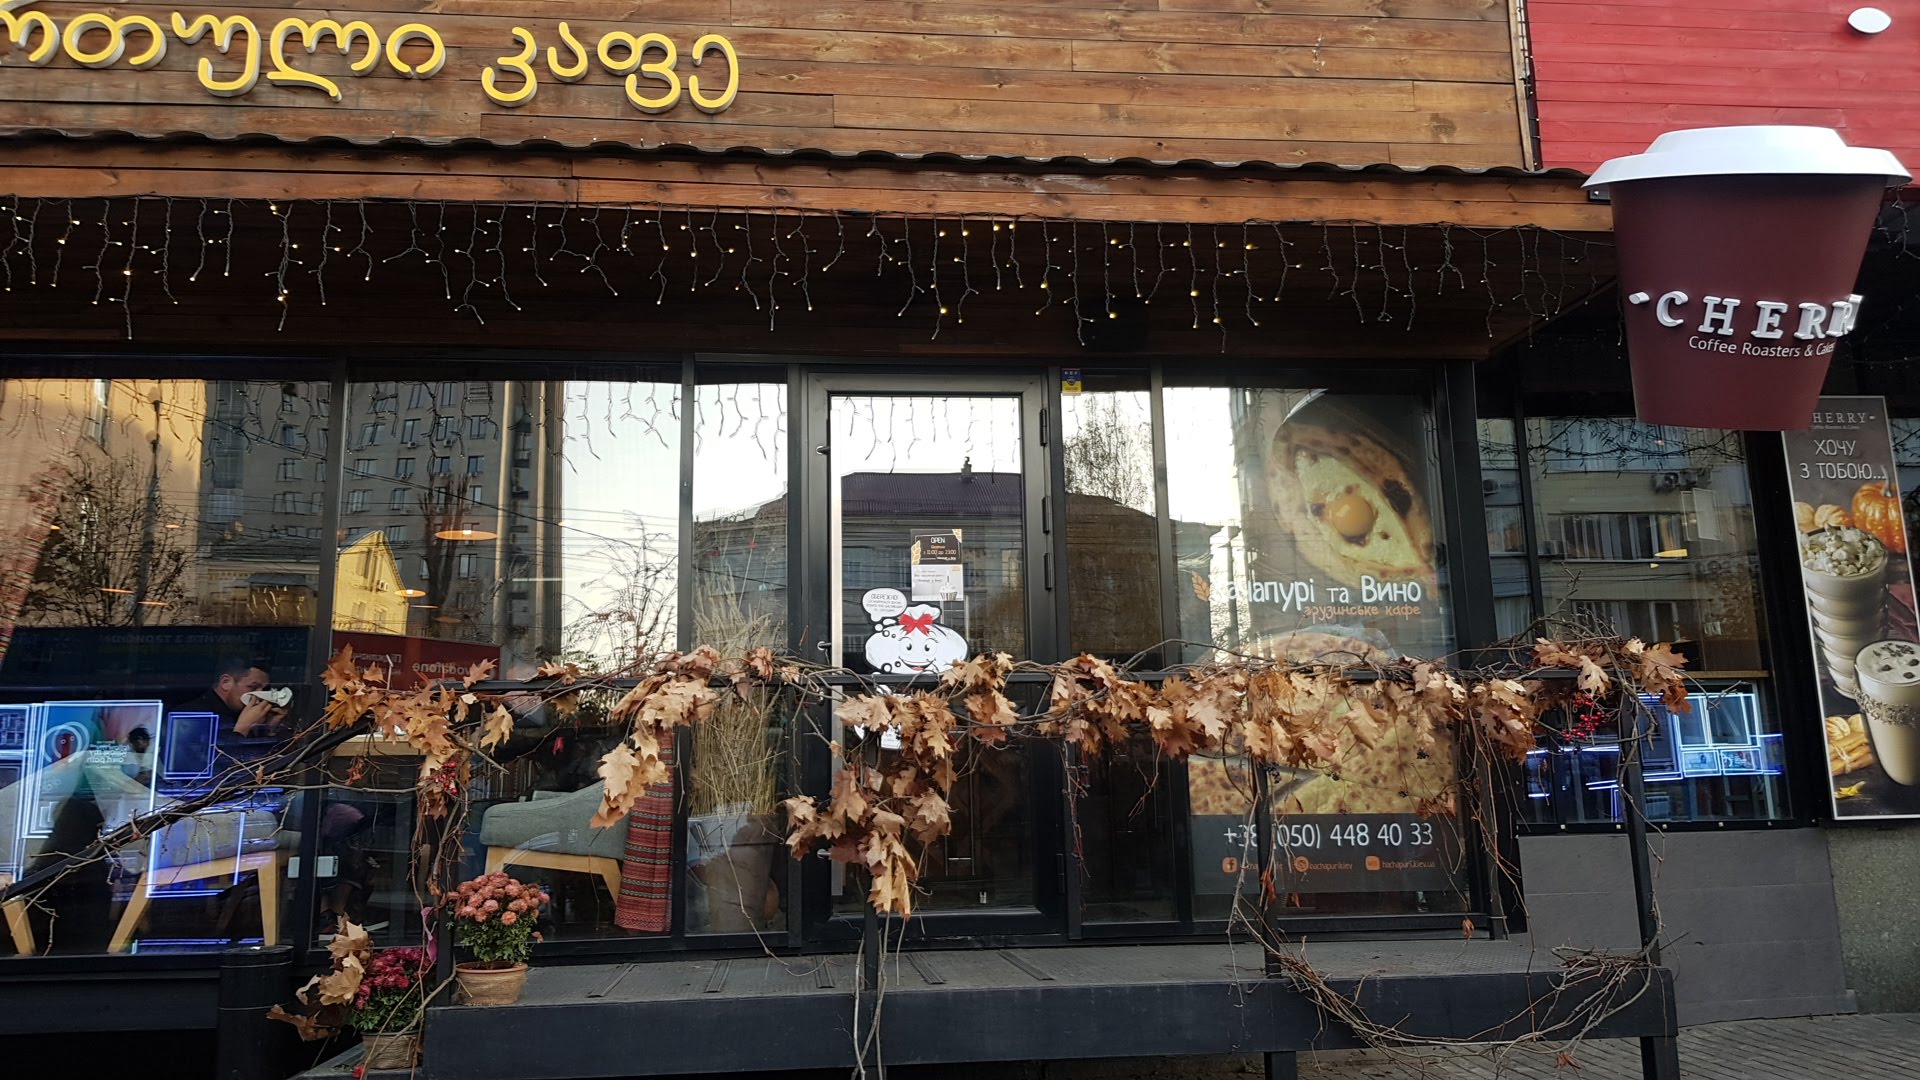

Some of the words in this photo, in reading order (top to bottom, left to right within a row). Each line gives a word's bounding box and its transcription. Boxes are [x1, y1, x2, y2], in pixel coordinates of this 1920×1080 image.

[481, 21, 739, 115] კაფე
[1689, 336, 1737, 354] Coffee
[1742, 341, 1800, 357] Roasters
[1804, 344, 1813, 357] &
[1812, 412, 1866, 423] HERRY
[1814, 439, 1856, 456] ХОЧУ
[1815, 462, 1886, 479] ТОБОЮ...
[1326, 587, 1349, 603] та
[1361, 575, 1421, 603] Вино
[1385, 603, 1421, 621] кафе
[1275, 823, 1320, 849] 050)
[1330, 822, 1369, 846] 448
[1377, 822, 1402, 846] 40
[1410, 822, 1432, 845] 33
